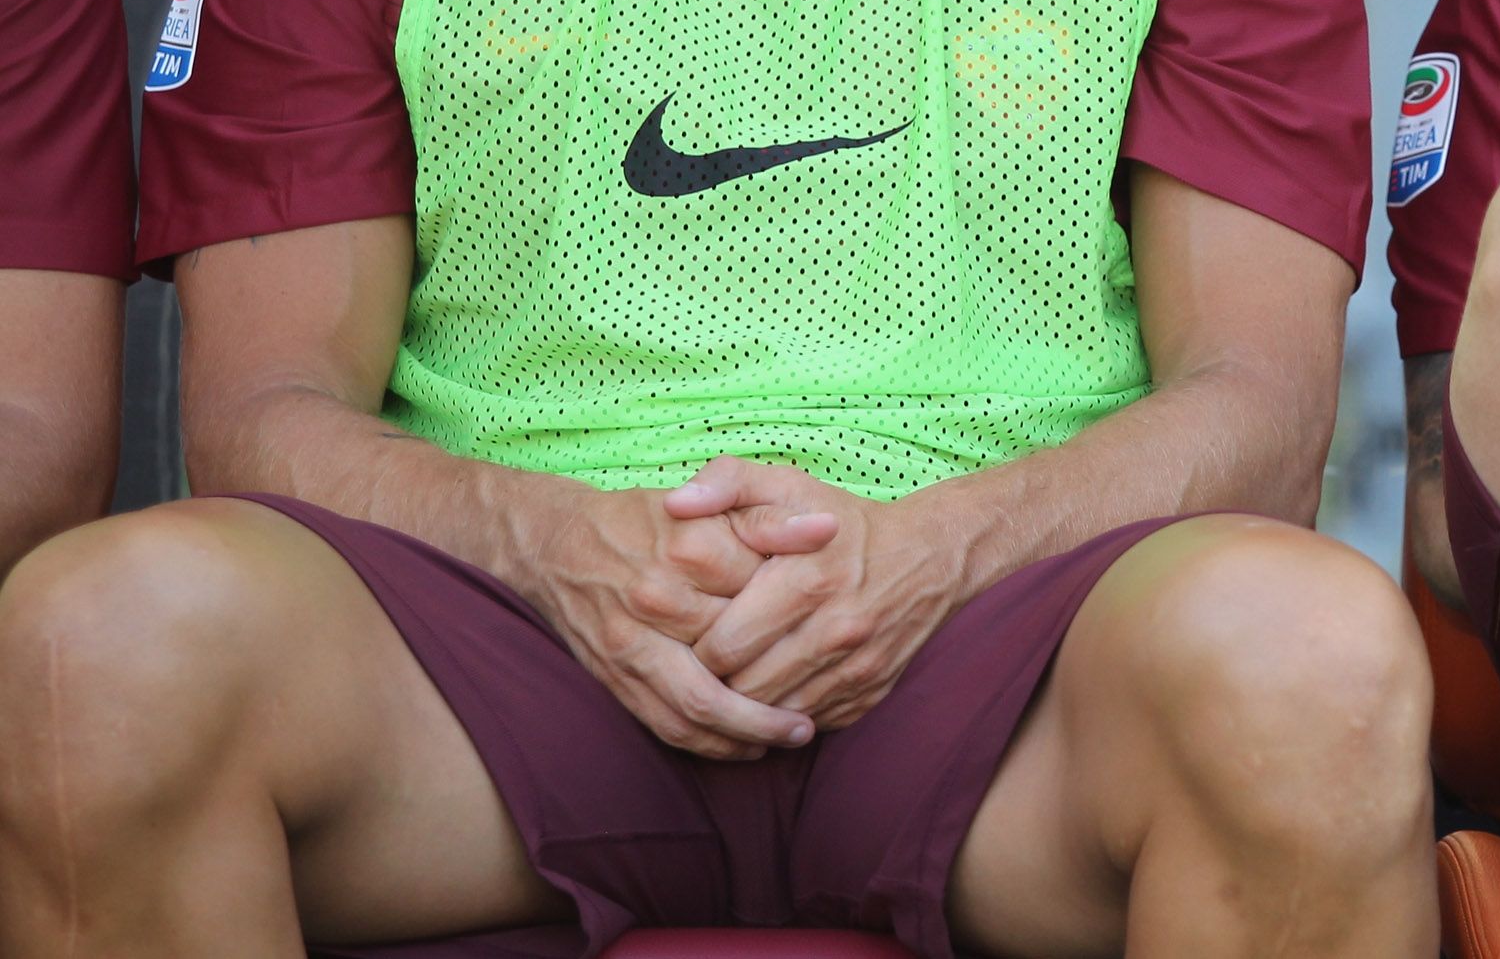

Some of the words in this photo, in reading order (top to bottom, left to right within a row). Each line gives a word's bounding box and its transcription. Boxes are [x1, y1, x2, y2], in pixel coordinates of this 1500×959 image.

[152, 52, 181, 77] TIM
[1393, 130, 1425, 154] ERIE
[1400, 160, 1429, 187] TIM
